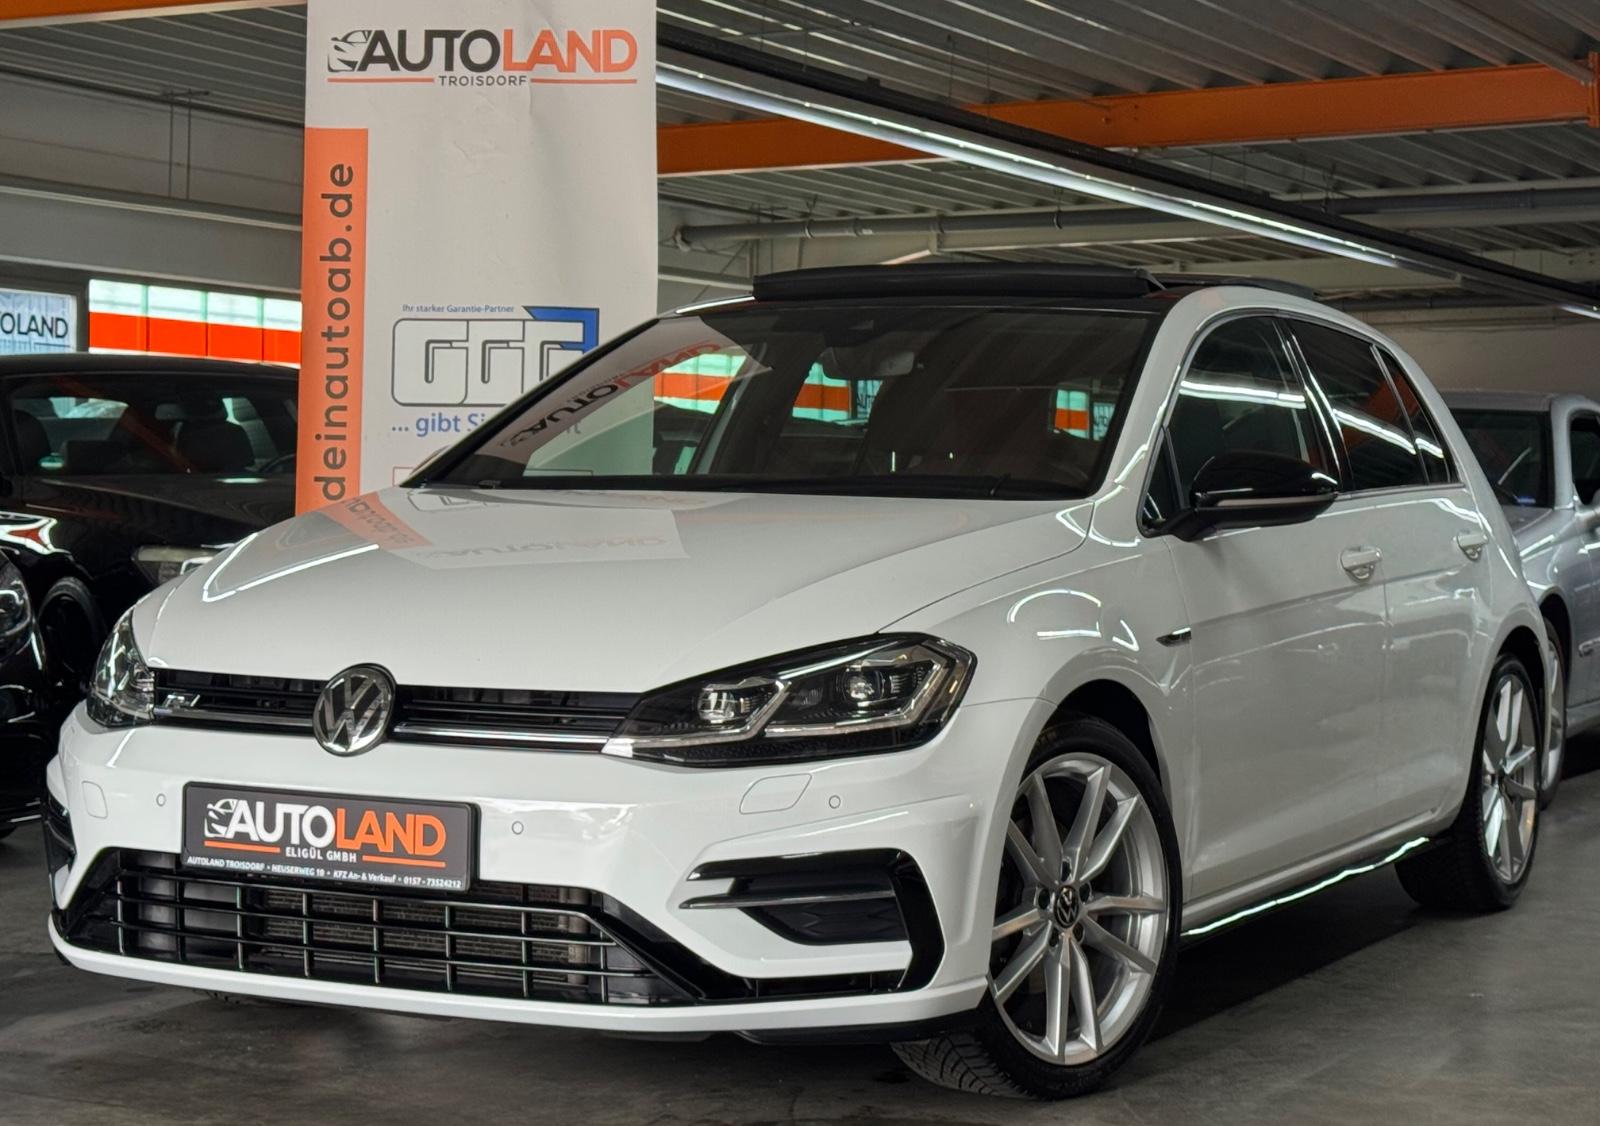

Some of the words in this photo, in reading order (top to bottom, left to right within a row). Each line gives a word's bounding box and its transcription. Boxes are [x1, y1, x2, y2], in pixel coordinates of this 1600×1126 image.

[357, 29, 638, 73] AUTOLAND
[438, 75, 528, 88] TROISDORF
[402, 304, 414, 313] Ihr
[416, 304, 445, 313] starker
[446, 304, 515, 313] Garantie-Partner
[0, 312, 69, 339] OLAND
[313, 162, 355, 501] deinautoab.de
[415, 412, 462, 438] gibt
[224, 799, 447, 857] AUTOLAND
[285, 846, 324, 860] ELIGÜL
[326, 850, 358, 863] GMBH
[187, 856, 225, 867] AUTOLAND
[225, 859, 265, 871] TROISDORF
[333, 869, 348, 877] KFZ
[368, 873, 397, 884] Verkauf
